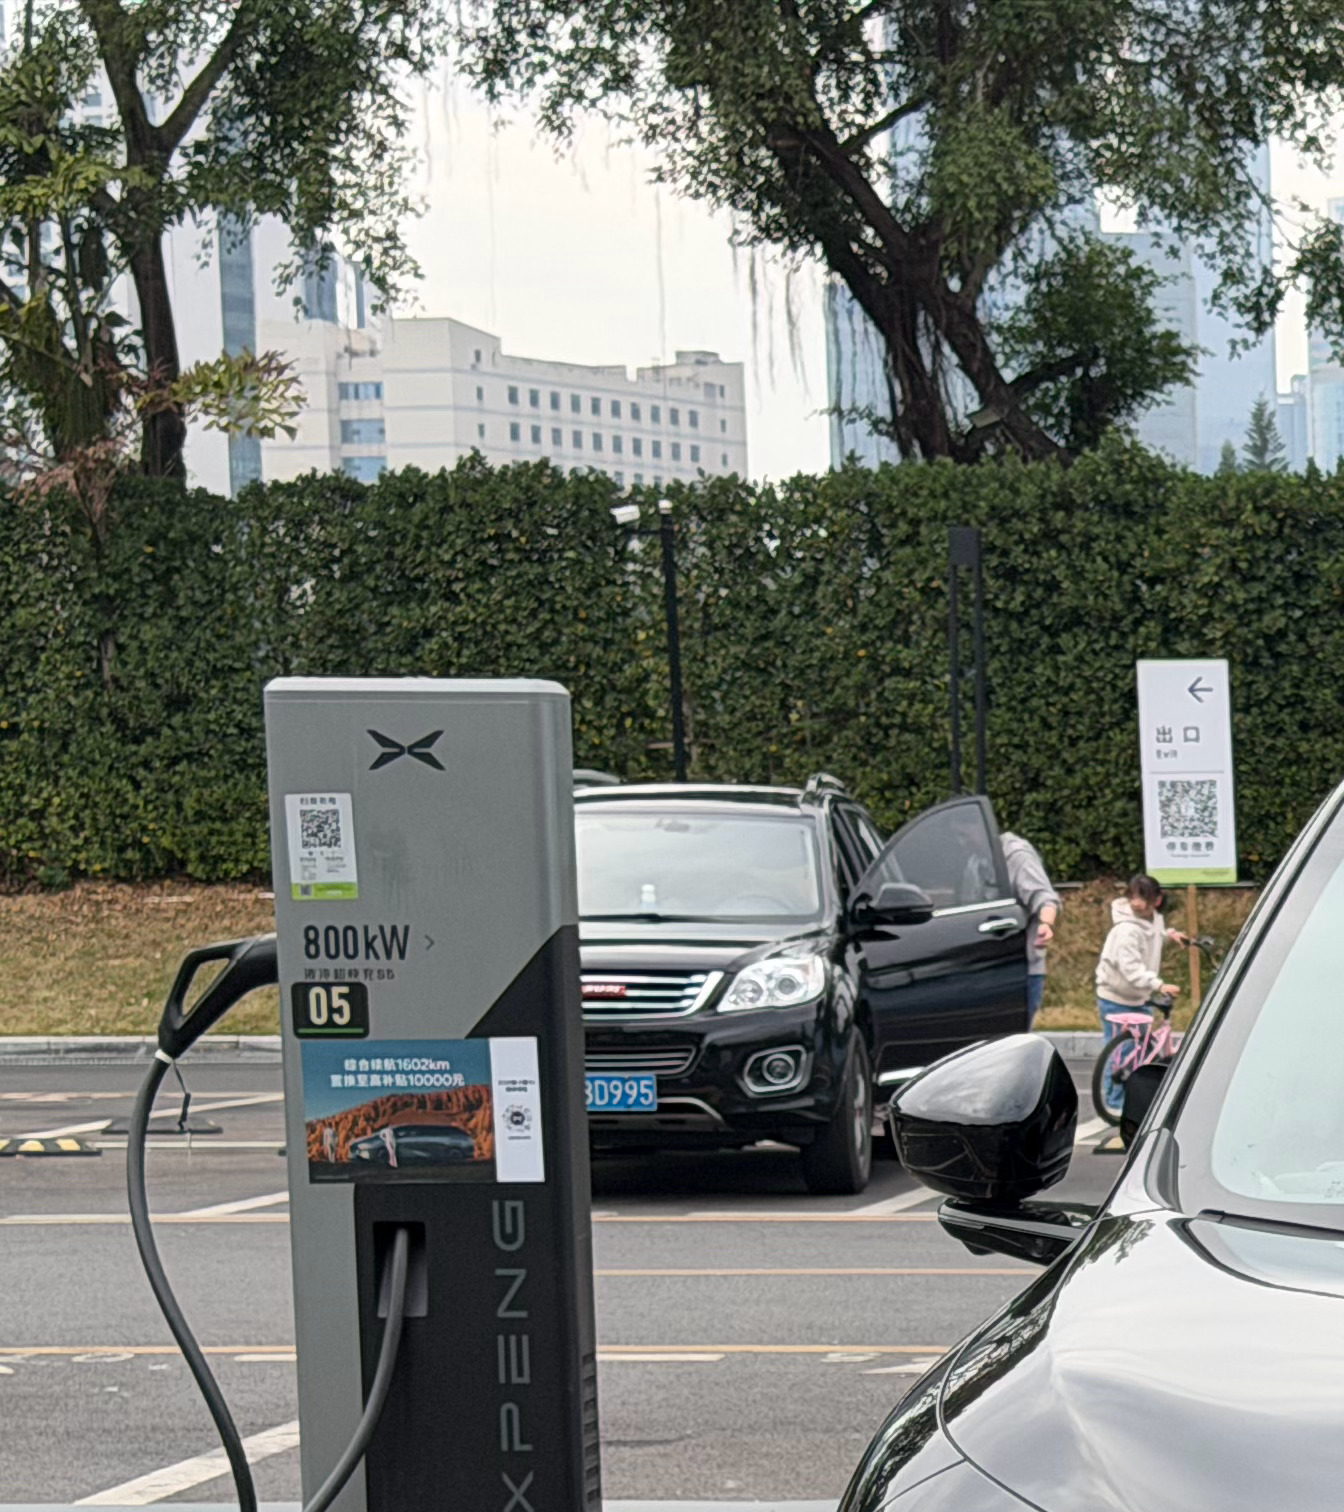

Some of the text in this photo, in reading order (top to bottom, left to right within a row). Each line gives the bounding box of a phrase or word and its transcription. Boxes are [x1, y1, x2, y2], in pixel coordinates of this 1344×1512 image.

[1155, 725, 1200, 744] 出口
[303, 924, 410, 961] 800kW
[308, 985, 351, 1026] 05
